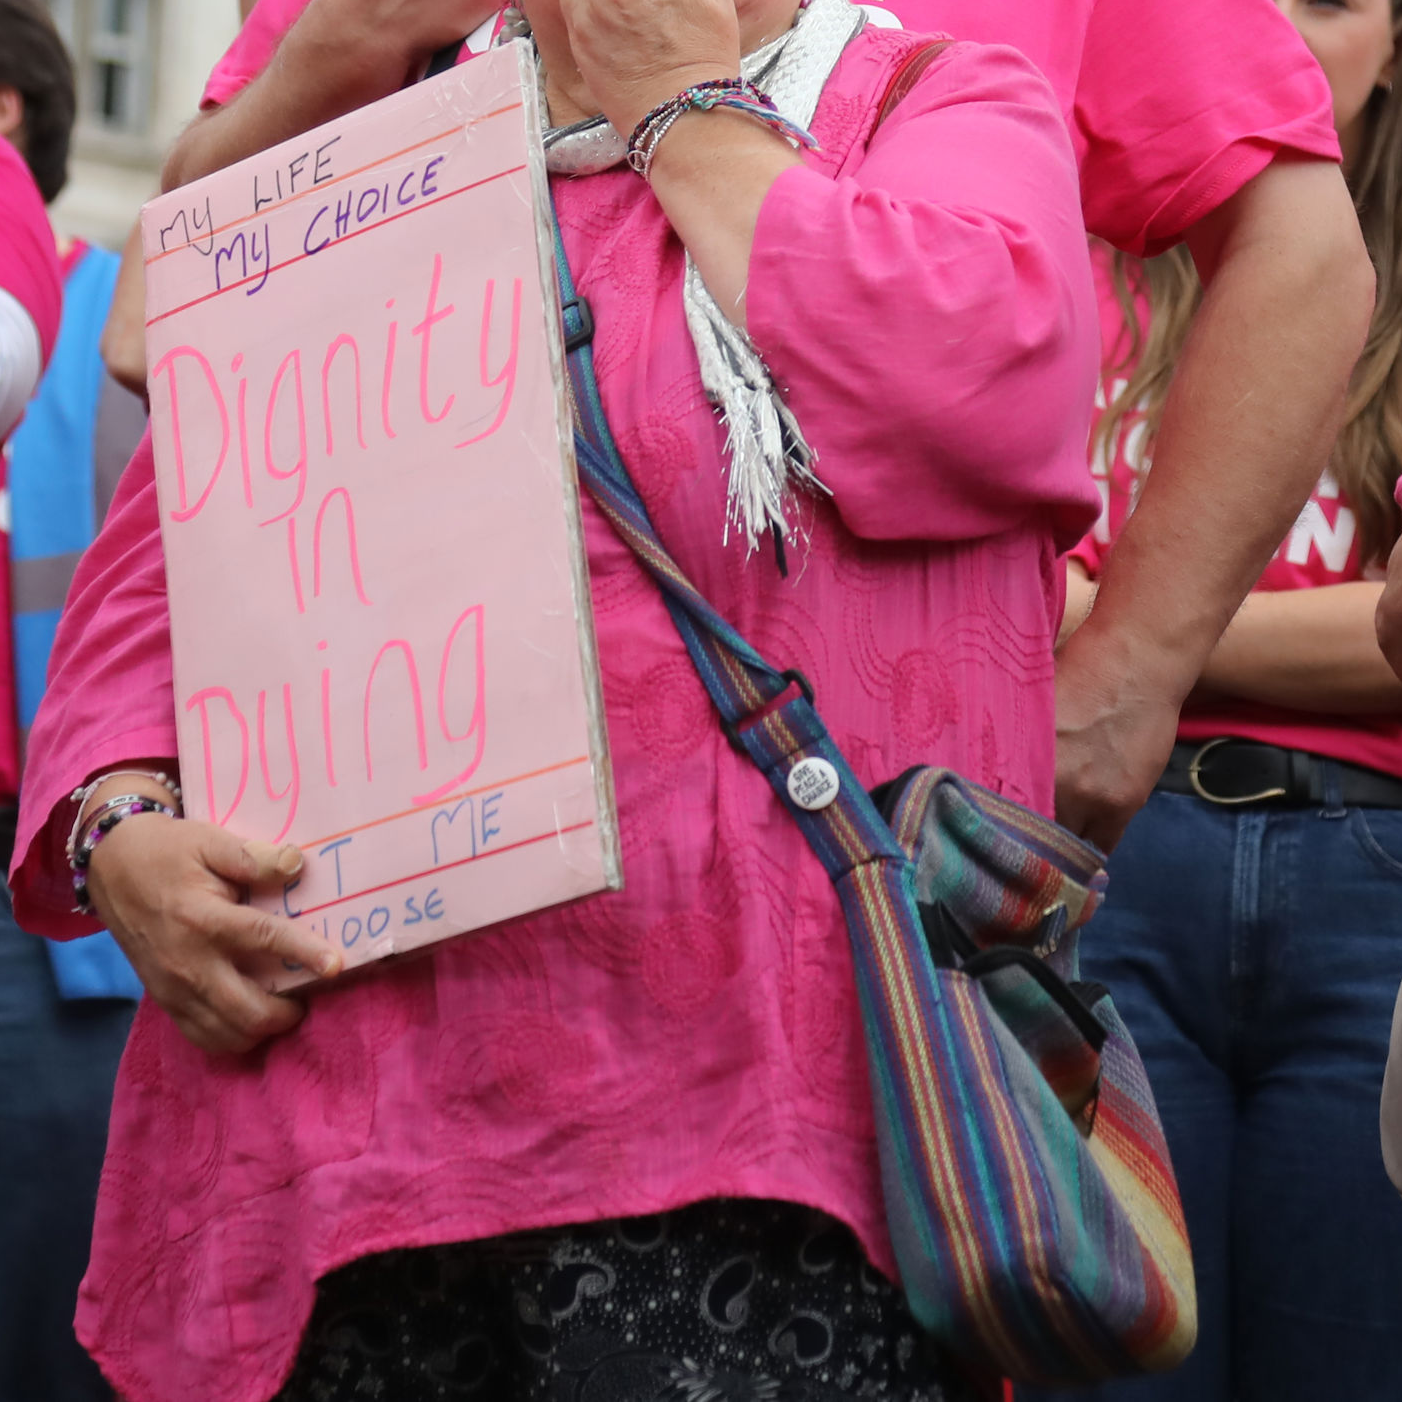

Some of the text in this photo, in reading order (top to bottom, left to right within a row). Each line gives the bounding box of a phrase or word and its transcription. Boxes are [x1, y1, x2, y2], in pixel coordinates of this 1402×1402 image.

[253, 135, 342, 214] LIFE
[302, 155, 445, 257] CHOICE
[152, 252, 523, 528] Dignity
[185, 602, 487, 846] Dying
[282, 791, 504, 920] ET ME
[282, 887, 446, 971] OOSE
